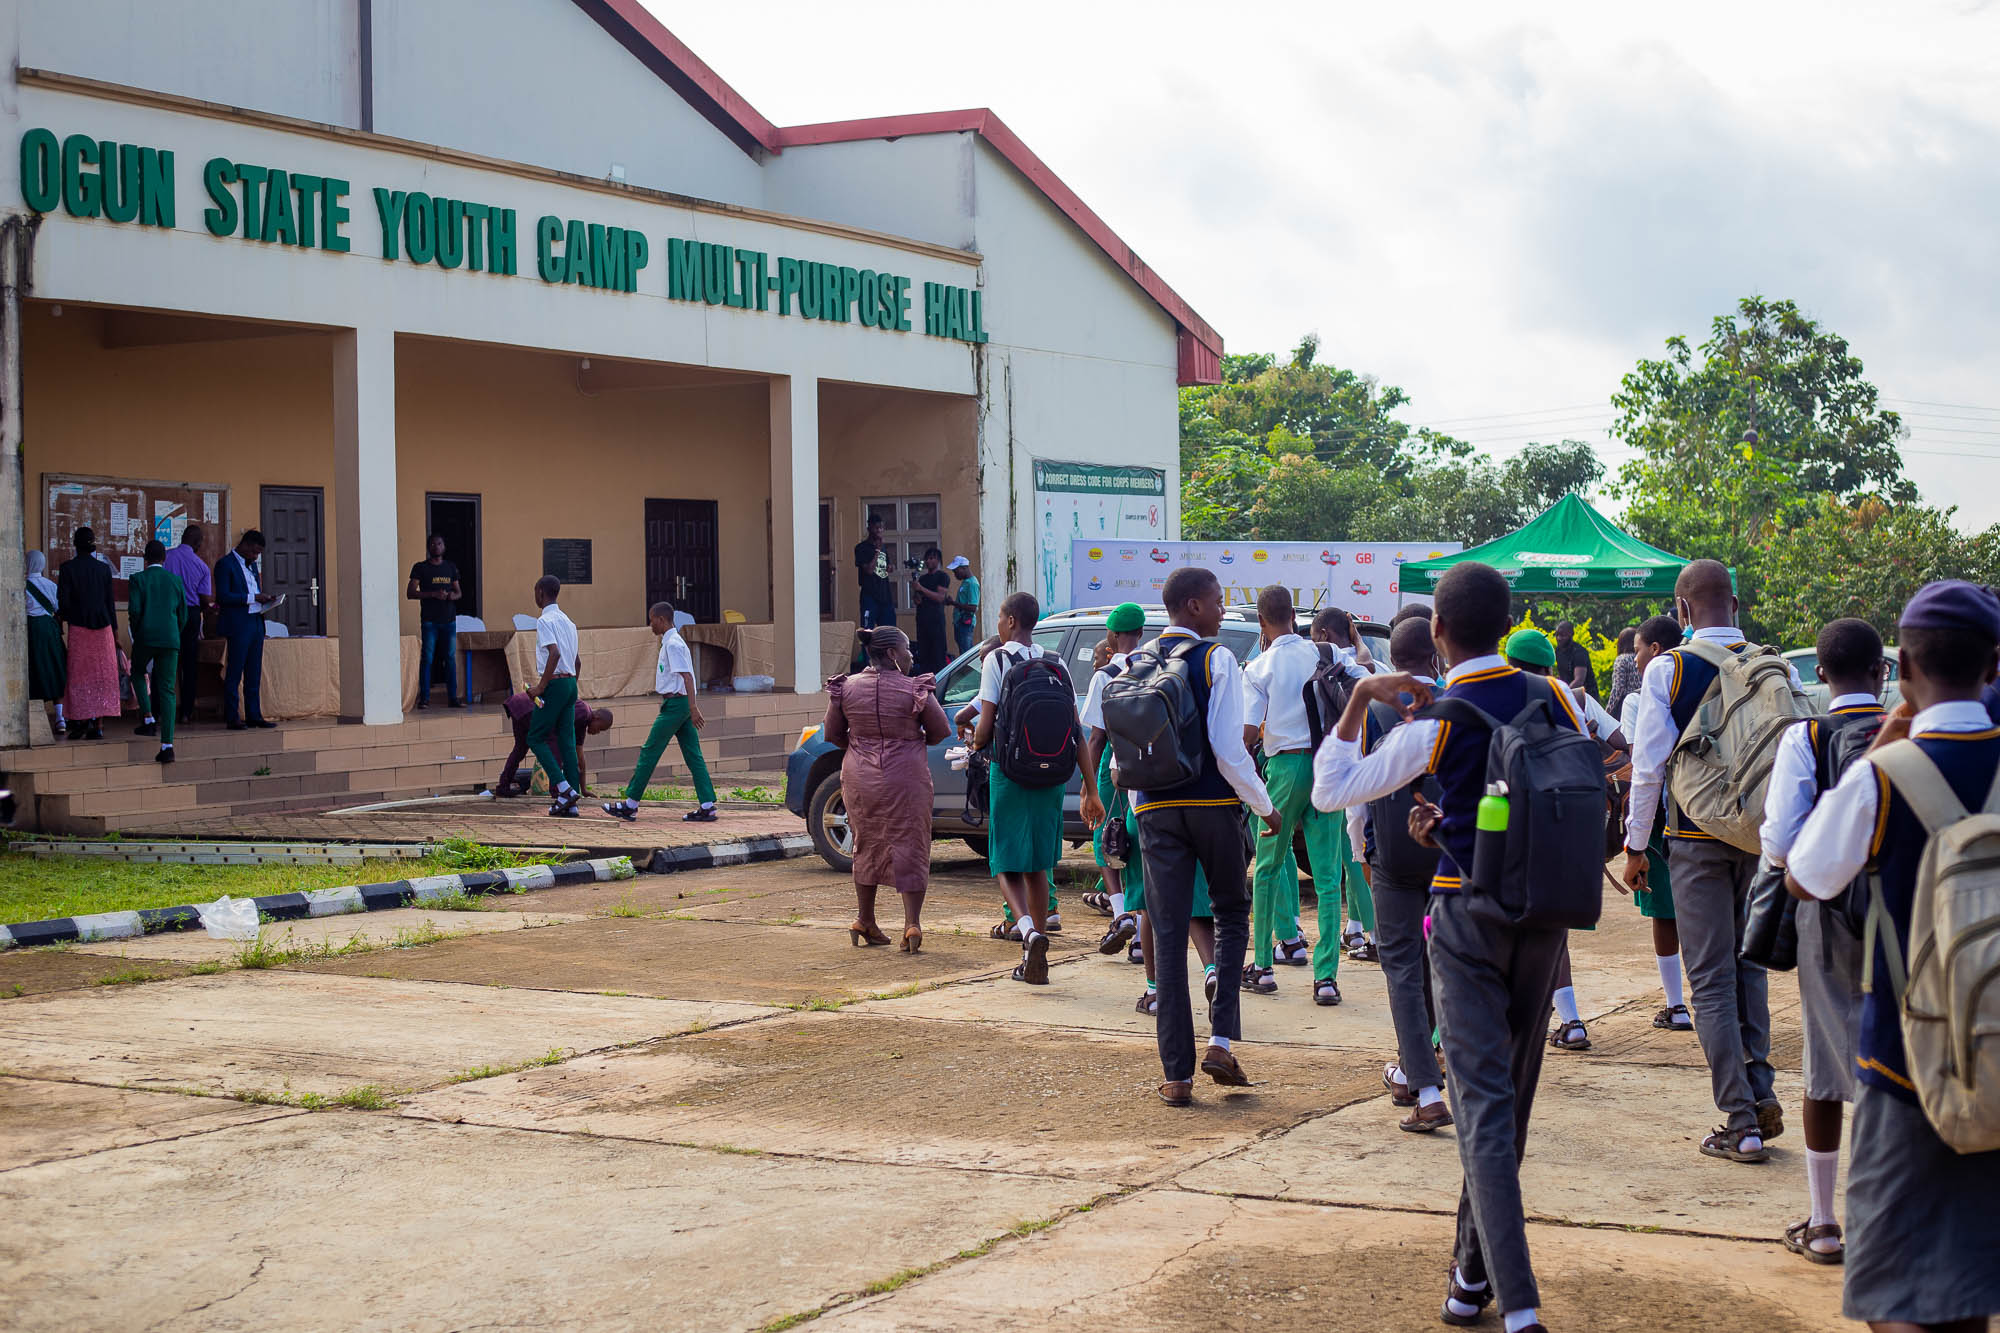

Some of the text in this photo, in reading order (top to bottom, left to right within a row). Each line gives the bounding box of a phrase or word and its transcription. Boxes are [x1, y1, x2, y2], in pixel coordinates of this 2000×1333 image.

[20, 128, 989, 344] OGUN STATE YOUTH CAMP MULTI-PURPOSE HALL
[1045, 473, 1155, 490] CORRECT DRESS CODE FOR CORPS MEMBERS
